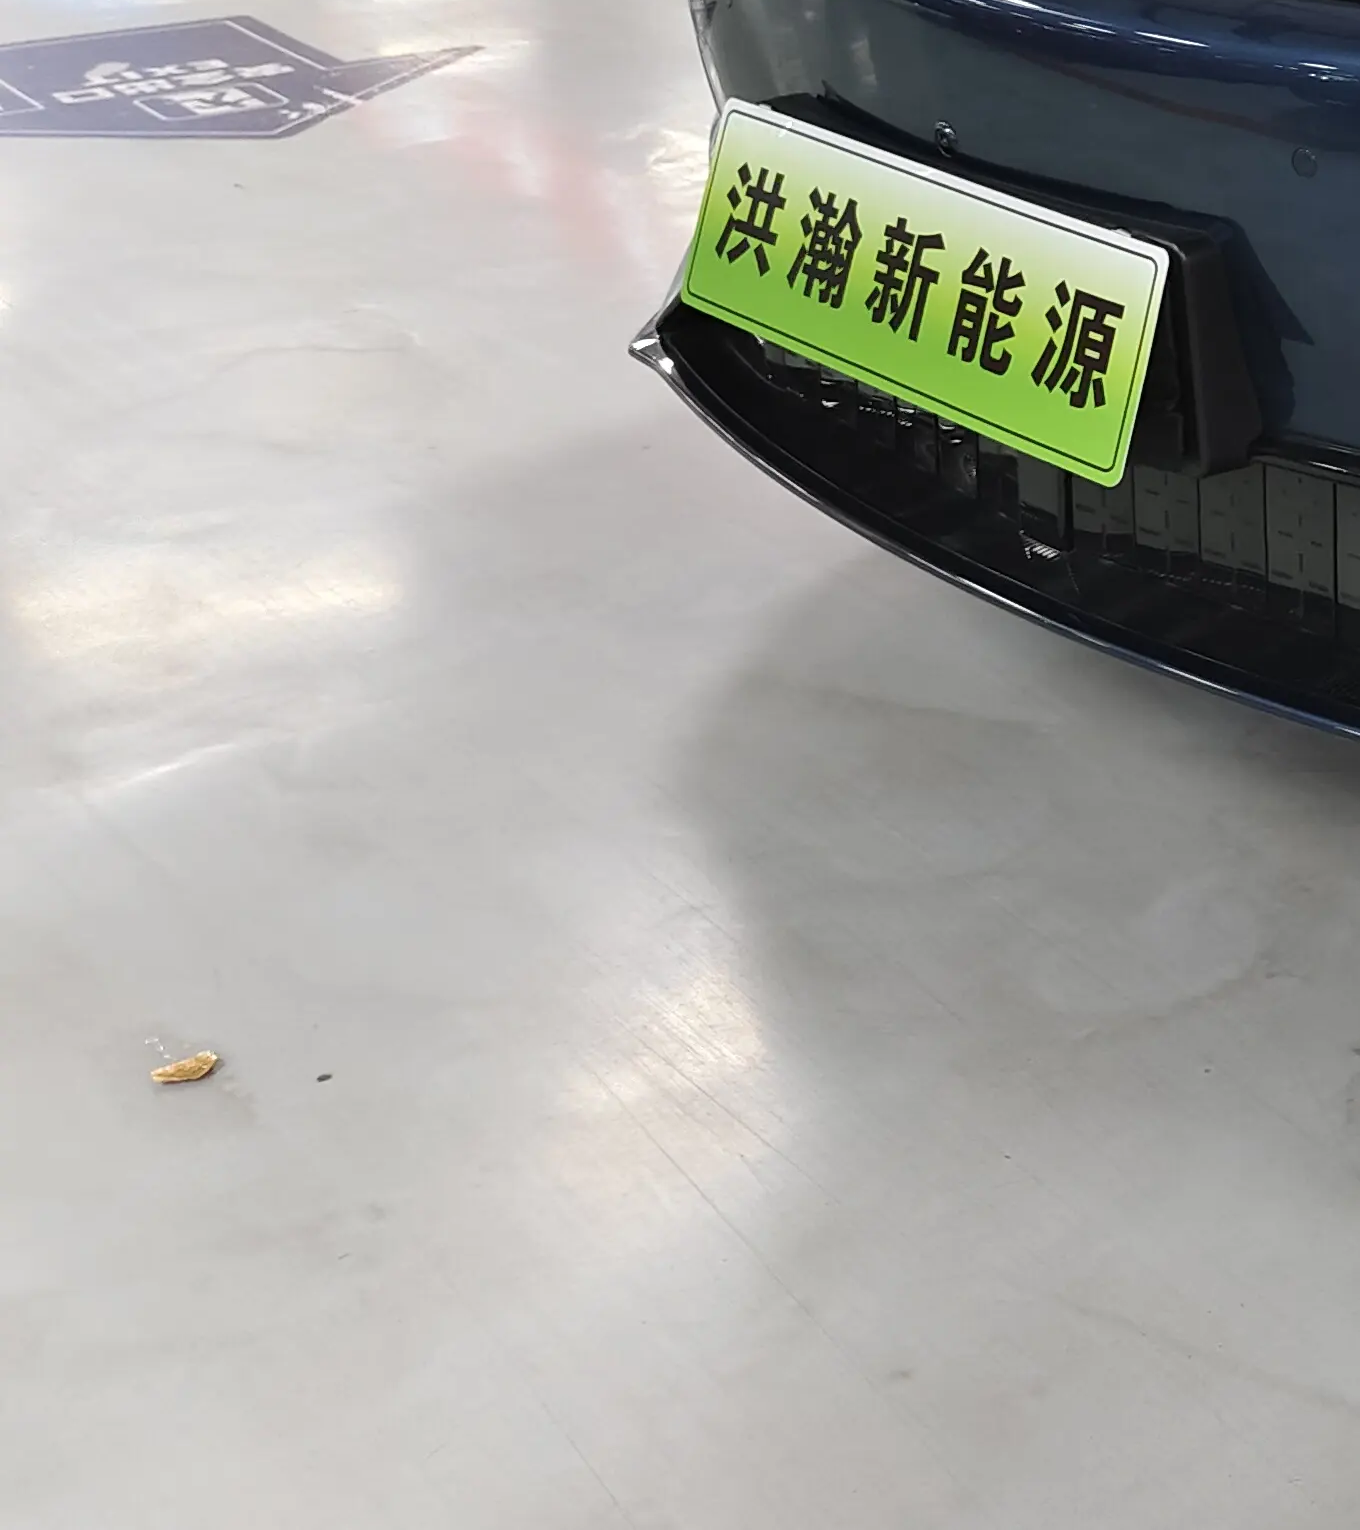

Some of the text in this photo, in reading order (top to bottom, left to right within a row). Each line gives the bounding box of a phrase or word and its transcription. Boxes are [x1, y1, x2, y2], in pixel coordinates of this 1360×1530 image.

[715, 162, 1126, 410] 洪瀚新能源
